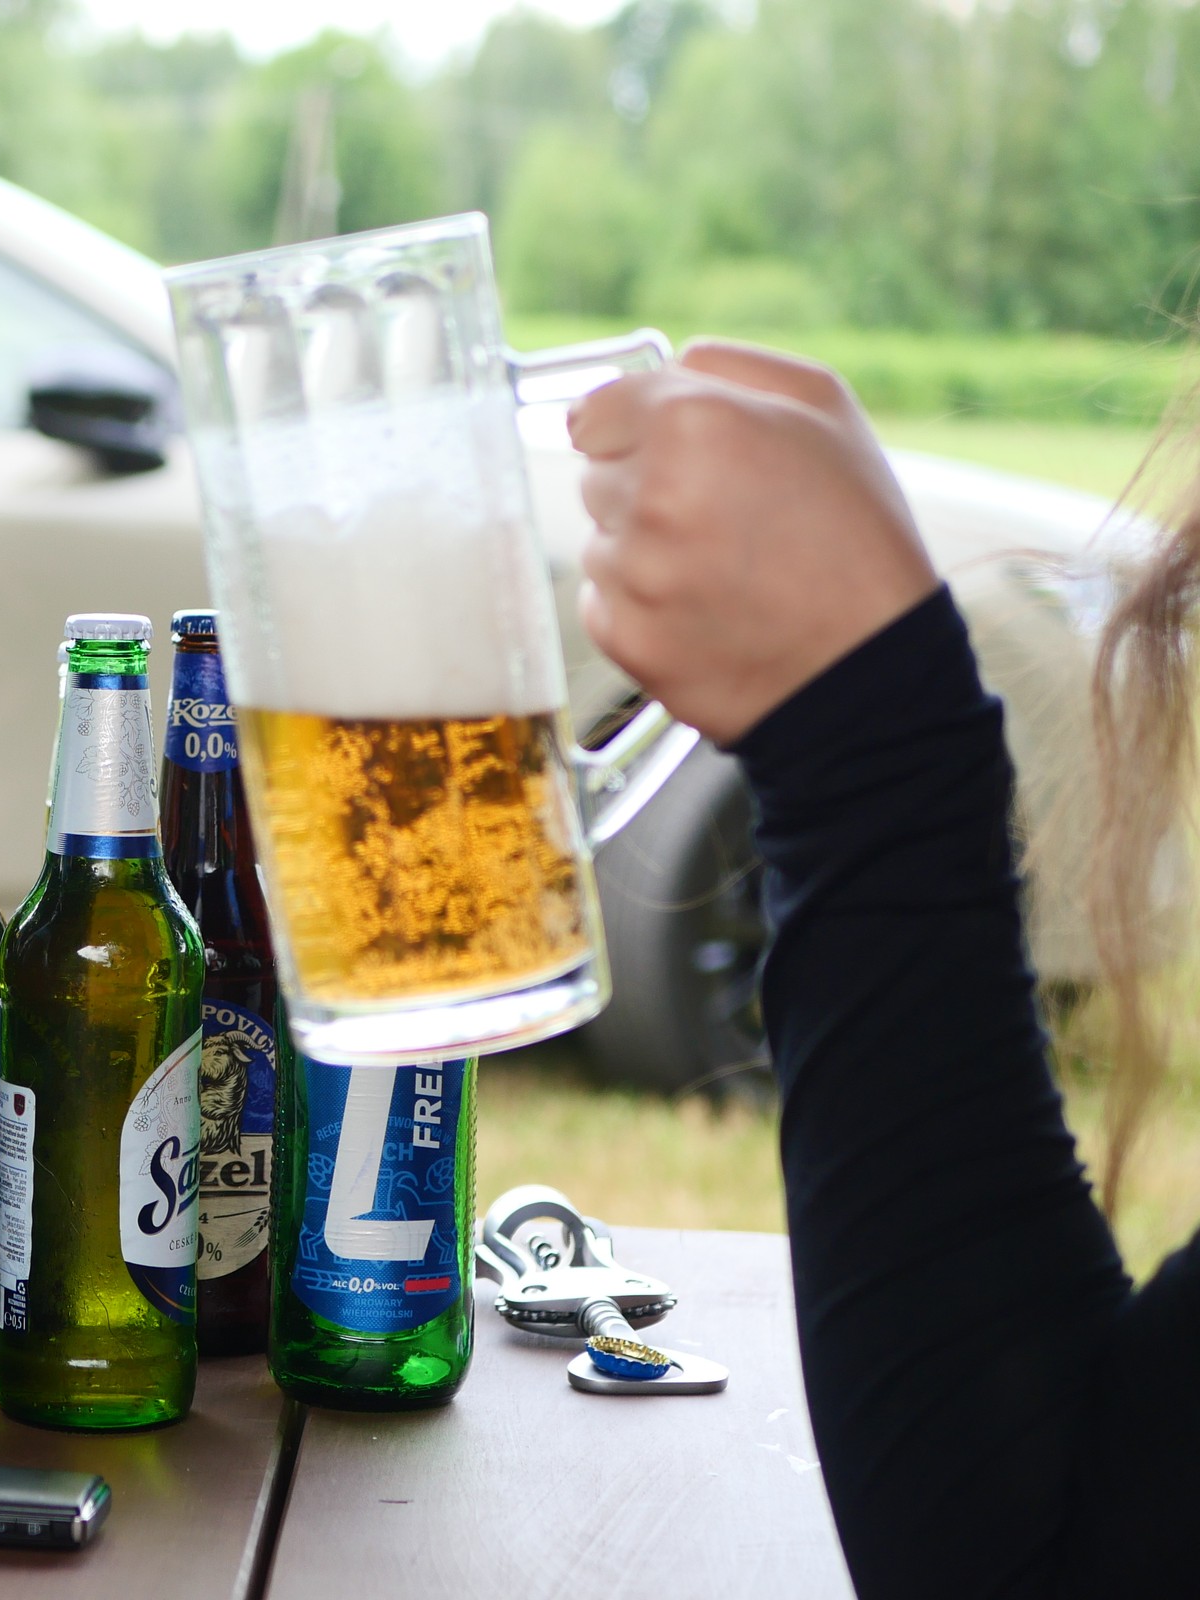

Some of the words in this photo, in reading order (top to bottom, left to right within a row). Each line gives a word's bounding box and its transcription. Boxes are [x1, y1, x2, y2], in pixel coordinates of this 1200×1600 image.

[172, 698, 239, 728] Koze
[185, 732, 237, 761] 0,0%
[173, 1095, 192, 1105] Anno
[332, 1280, 348, 1288] ALC
[354, 1298, 403, 1309] BROWARY
[341, 1307, 413, 1319] WIELKOPOLSKI
